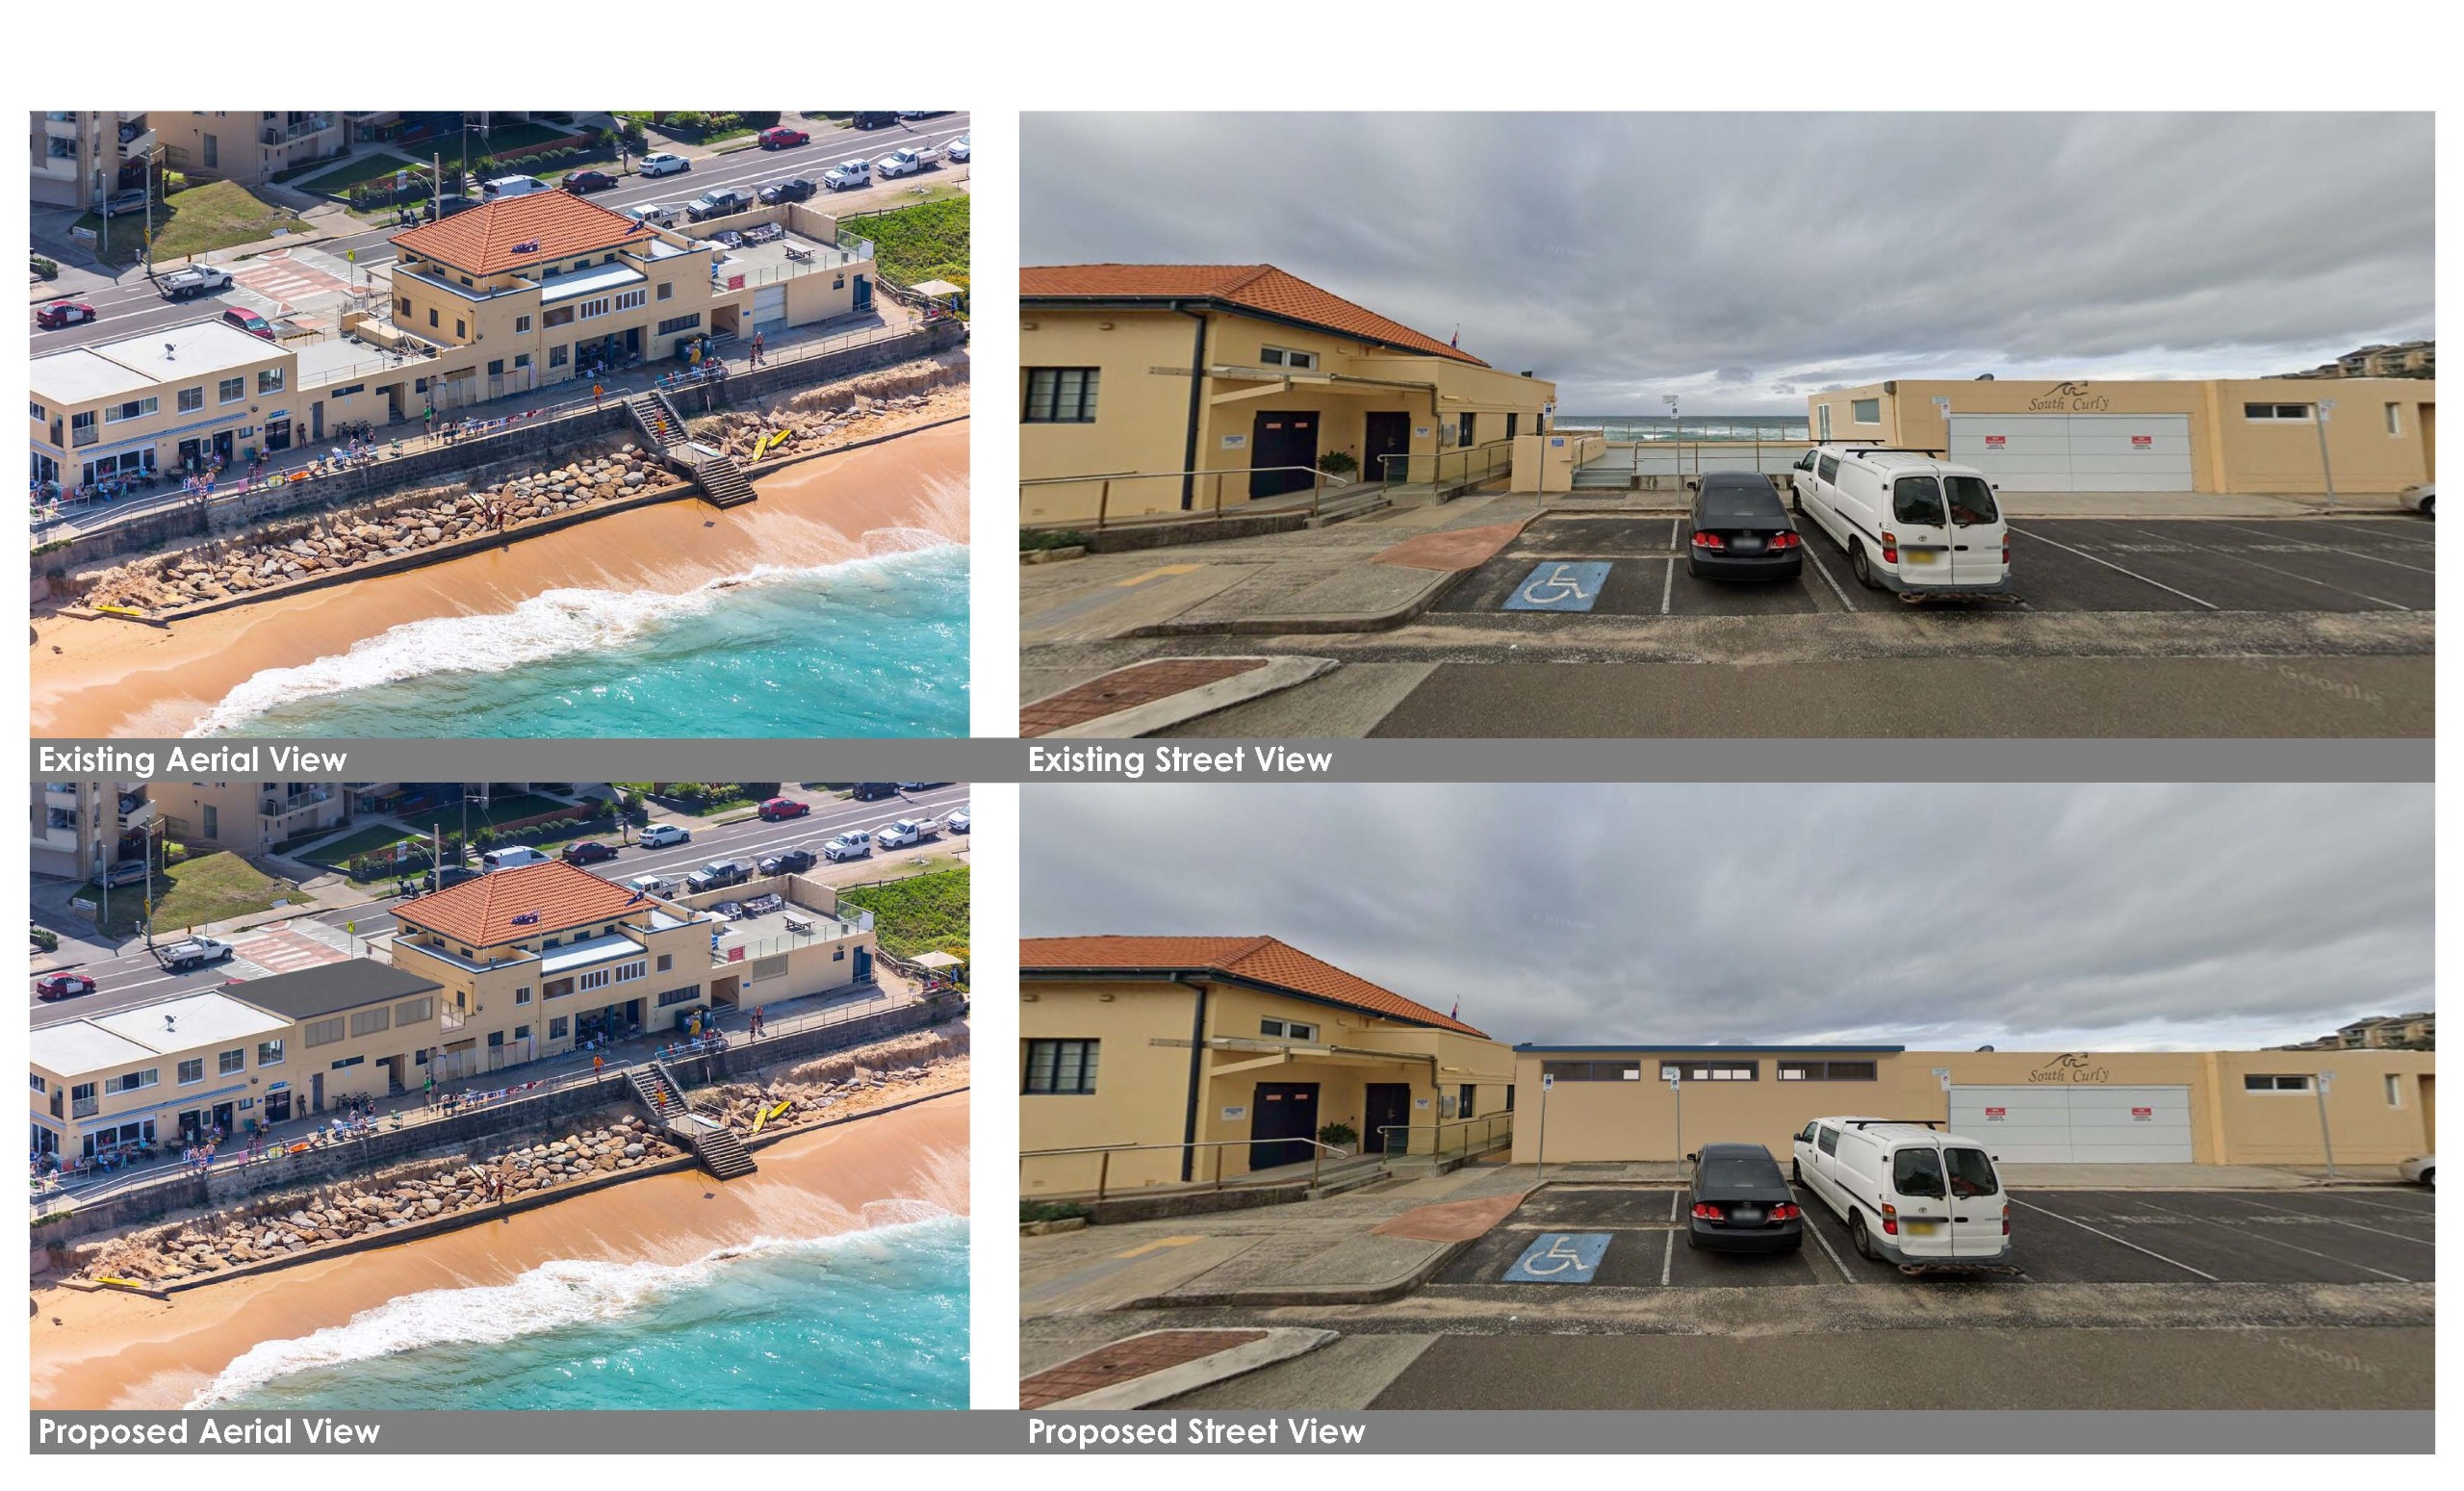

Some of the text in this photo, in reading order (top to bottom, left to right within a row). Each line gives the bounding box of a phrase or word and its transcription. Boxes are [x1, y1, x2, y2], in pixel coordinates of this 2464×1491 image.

[2028, 395, 2110, 412] South Curly
[2028, 1067, 2110, 1084] South Curly
